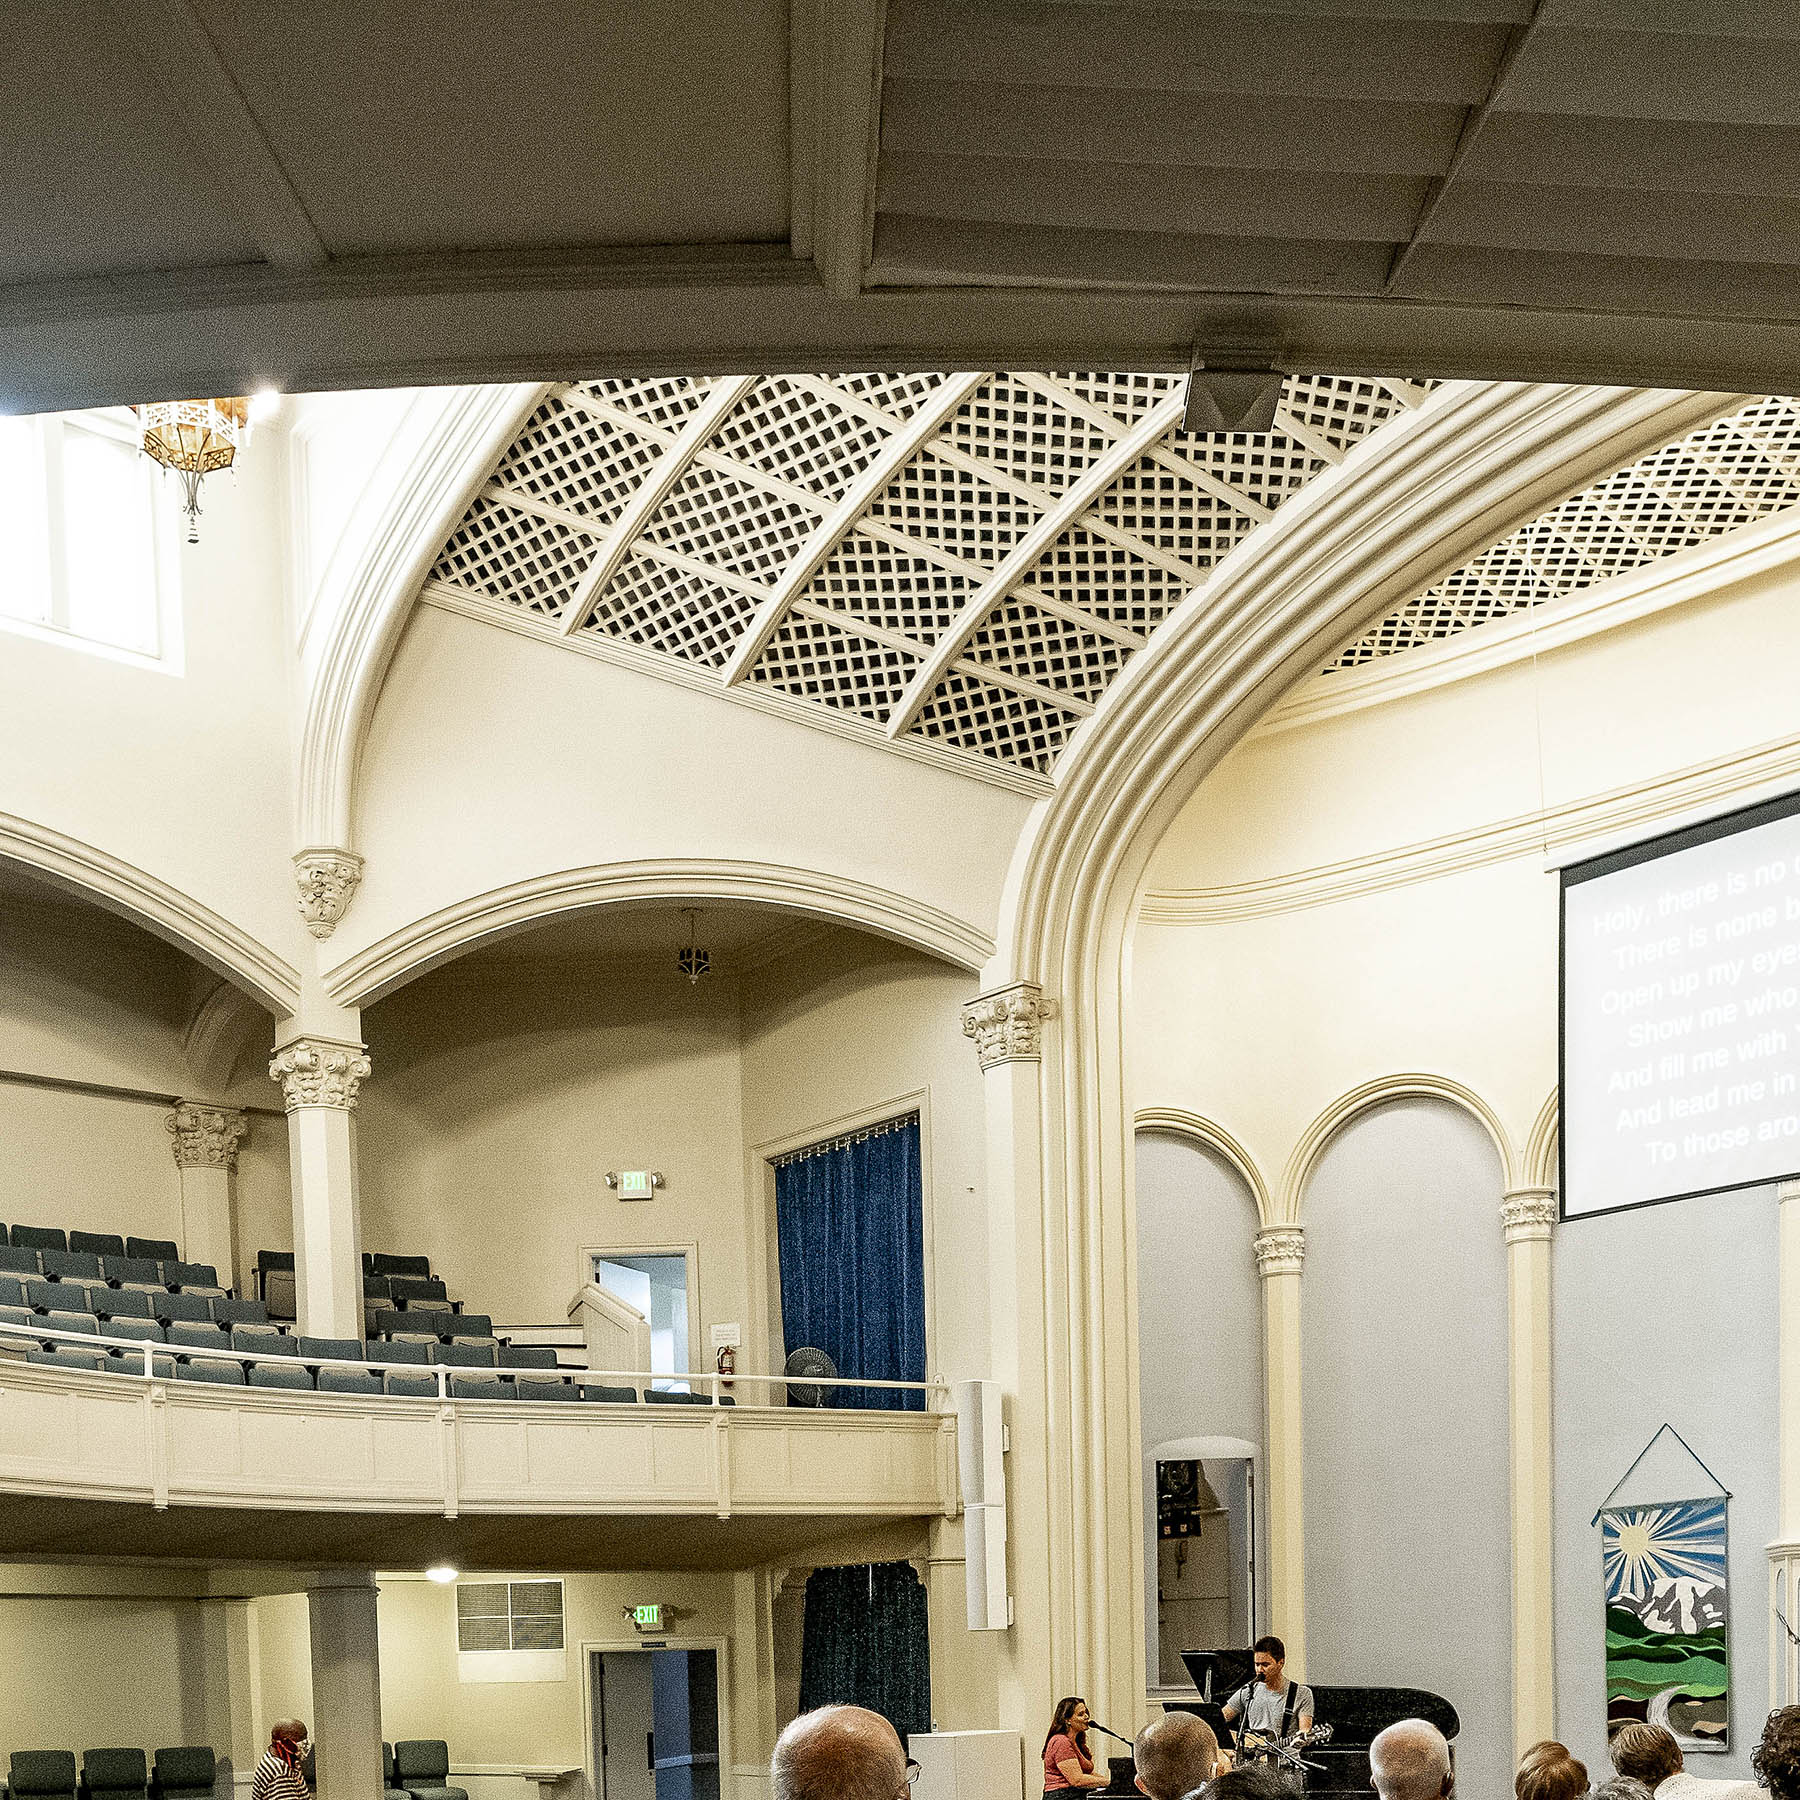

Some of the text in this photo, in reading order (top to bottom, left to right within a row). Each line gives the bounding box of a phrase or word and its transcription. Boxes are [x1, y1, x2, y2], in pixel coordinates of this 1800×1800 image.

[1593, 904, 1650, 936] Holy,
[1657, 882, 1719, 916] there
[1727, 872, 1748, 895] is
[1755, 861, 1786, 887] no
[1613, 936, 1680, 969] There
[1689, 925, 1707, 948] is
[1715, 907, 1777, 942] none
[1601, 982, 1663, 1015] Open
[1671, 972, 1700, 998] up
[1707, 959, 1744, 986] my
[1628, 1015, 1693, 1047] Show
[1700, 1003, 1738, 1029] me
[1744, 987, 1798, 1017] who
[1608, 1062, 1653, 1094] And
[1659, 1053, 1685, 1080] fill
[1692, 1048, 1730, 1072] me
[1736, 1029, 1787, 1062] with
[1616, 1099, 1662, 1133] And
[1669, 1085, 1719, 1120] lead
[1727, 1081, 1765, 1106] me
[1773, 1072, 1795, 1096] in
[1644, 1140, 1677, 1165] To
[1683, 1126, 1750, 1158] those
[623, 1171, 646, 1190] EXIT
[636, 1604, 658, 1624] EXIT
